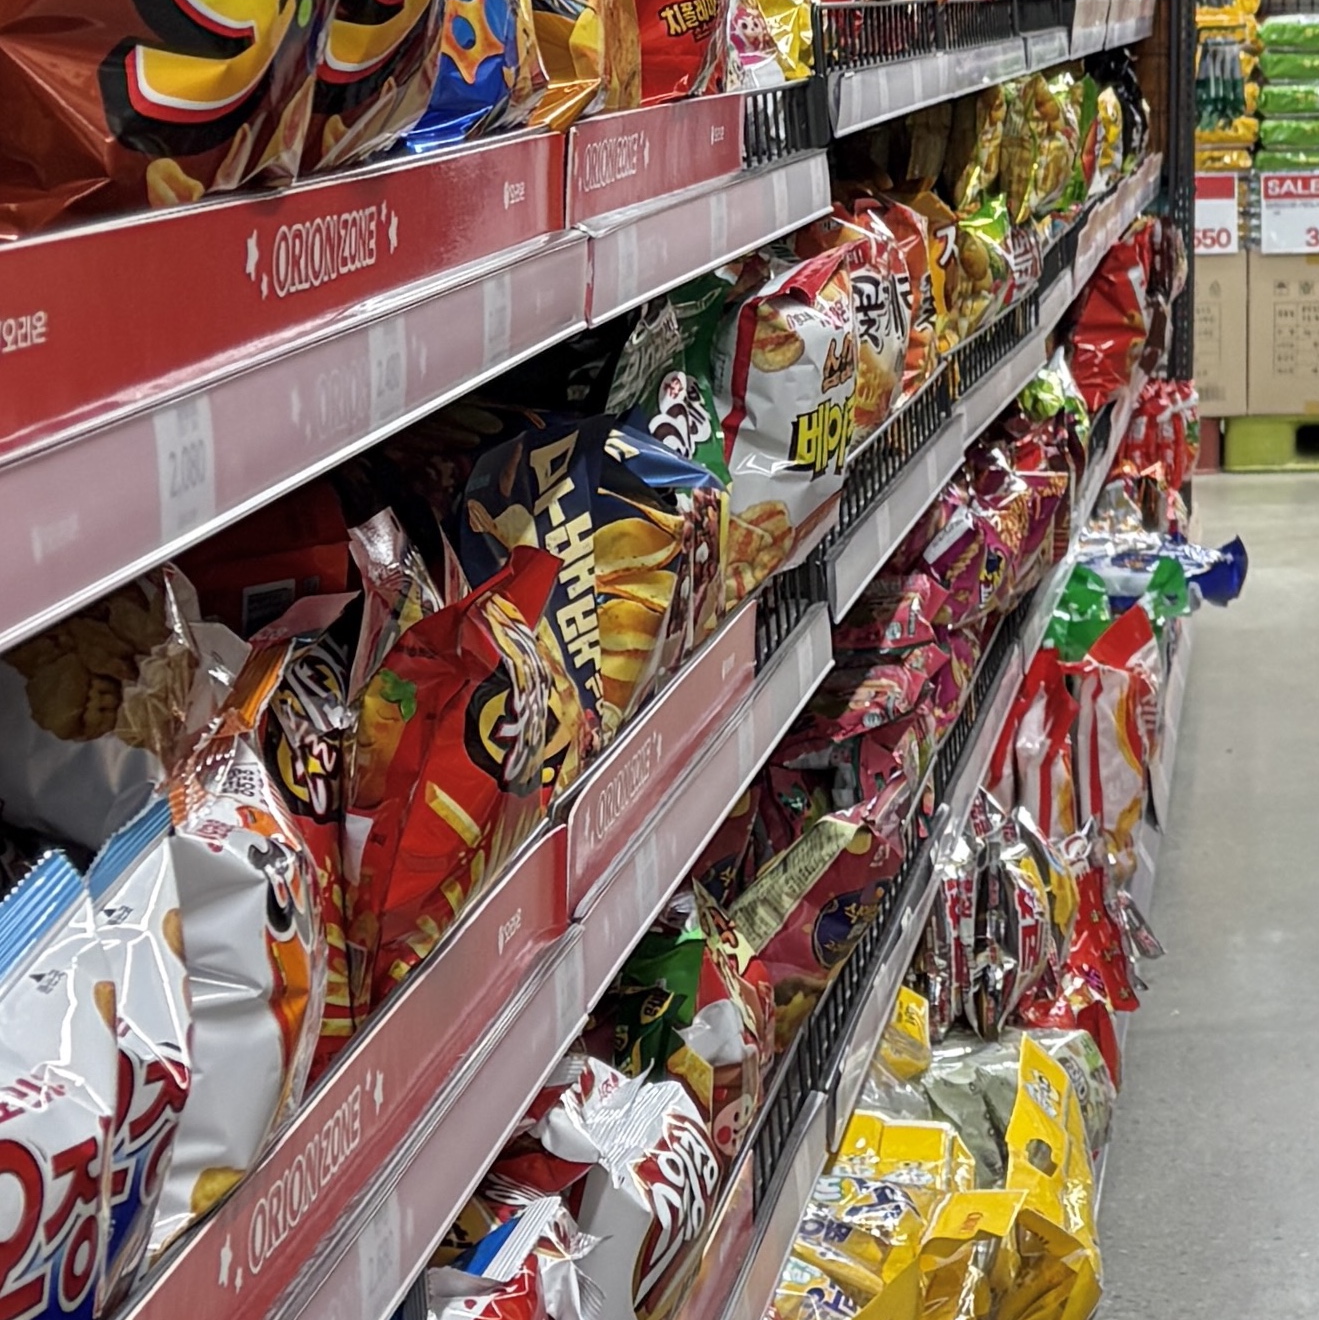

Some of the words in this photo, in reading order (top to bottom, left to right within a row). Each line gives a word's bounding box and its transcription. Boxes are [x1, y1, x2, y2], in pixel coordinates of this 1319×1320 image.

[272, 220, 337, 296] ORION
[336, 206, 377, 273] ZONE
[2, 313, 48, 350] 오리온
[248, 1135, 321, 1274] ORION
[320, 1085, 362, 1187] ZONE
